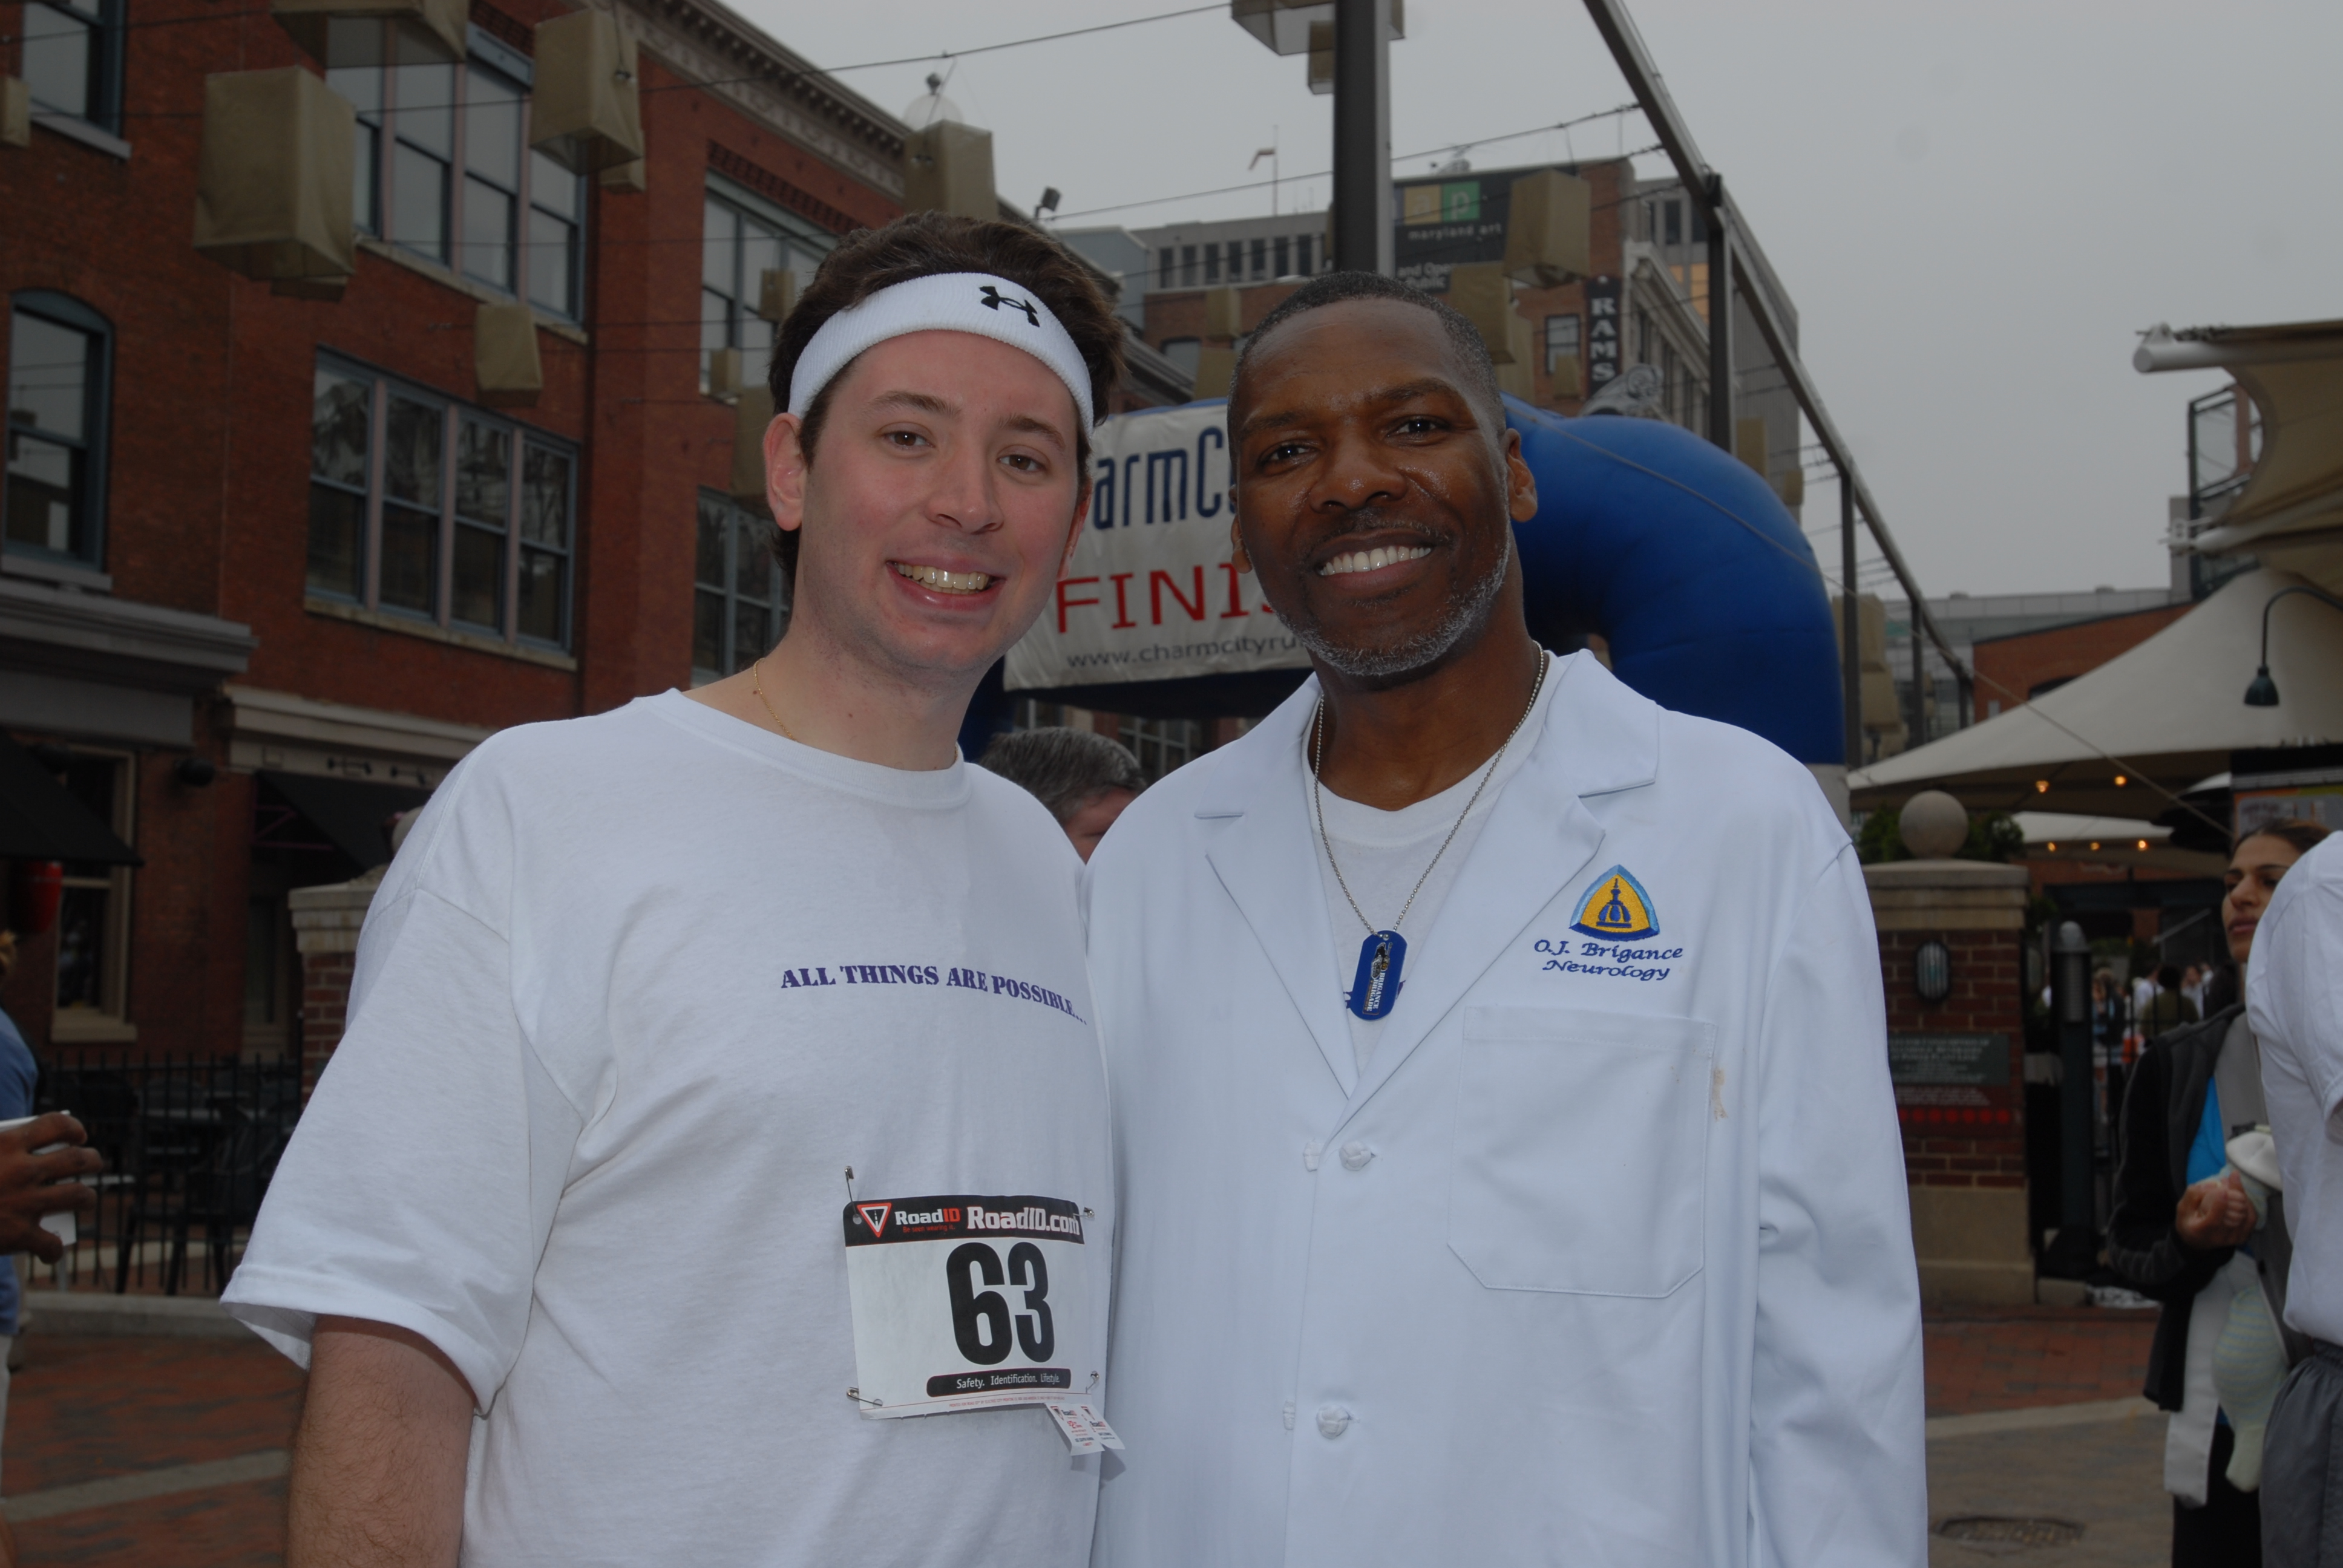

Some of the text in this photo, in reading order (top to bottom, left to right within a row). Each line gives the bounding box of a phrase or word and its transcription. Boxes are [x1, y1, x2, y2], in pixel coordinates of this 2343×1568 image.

[1407, 223, 1502, 241] maryland art
[1423, 262, 1452, 276] Ope
[1590, 297, 1617, 382] RAMS
[1093, 425, 1236, 530] armC
[1056, 561, 1274, 634] FINI
[1067, 634, 1306, 667] www.charmcityru
[1534, 939, 1683, 963] O.J. Brigance
[781, 967, 836, 988] ALL
[840, 965, 940, 985] THINGS
[946, 967, 989, 992] ARE
[1542, 960, 1671, 981] Neurology
[895, 1206, 1080, 1235] RoadID RoadID.com
[946, 1241, 1055, 1365] 63
[956, 1373, 1060, 1389] Safety. Identification. Lifestyle.
